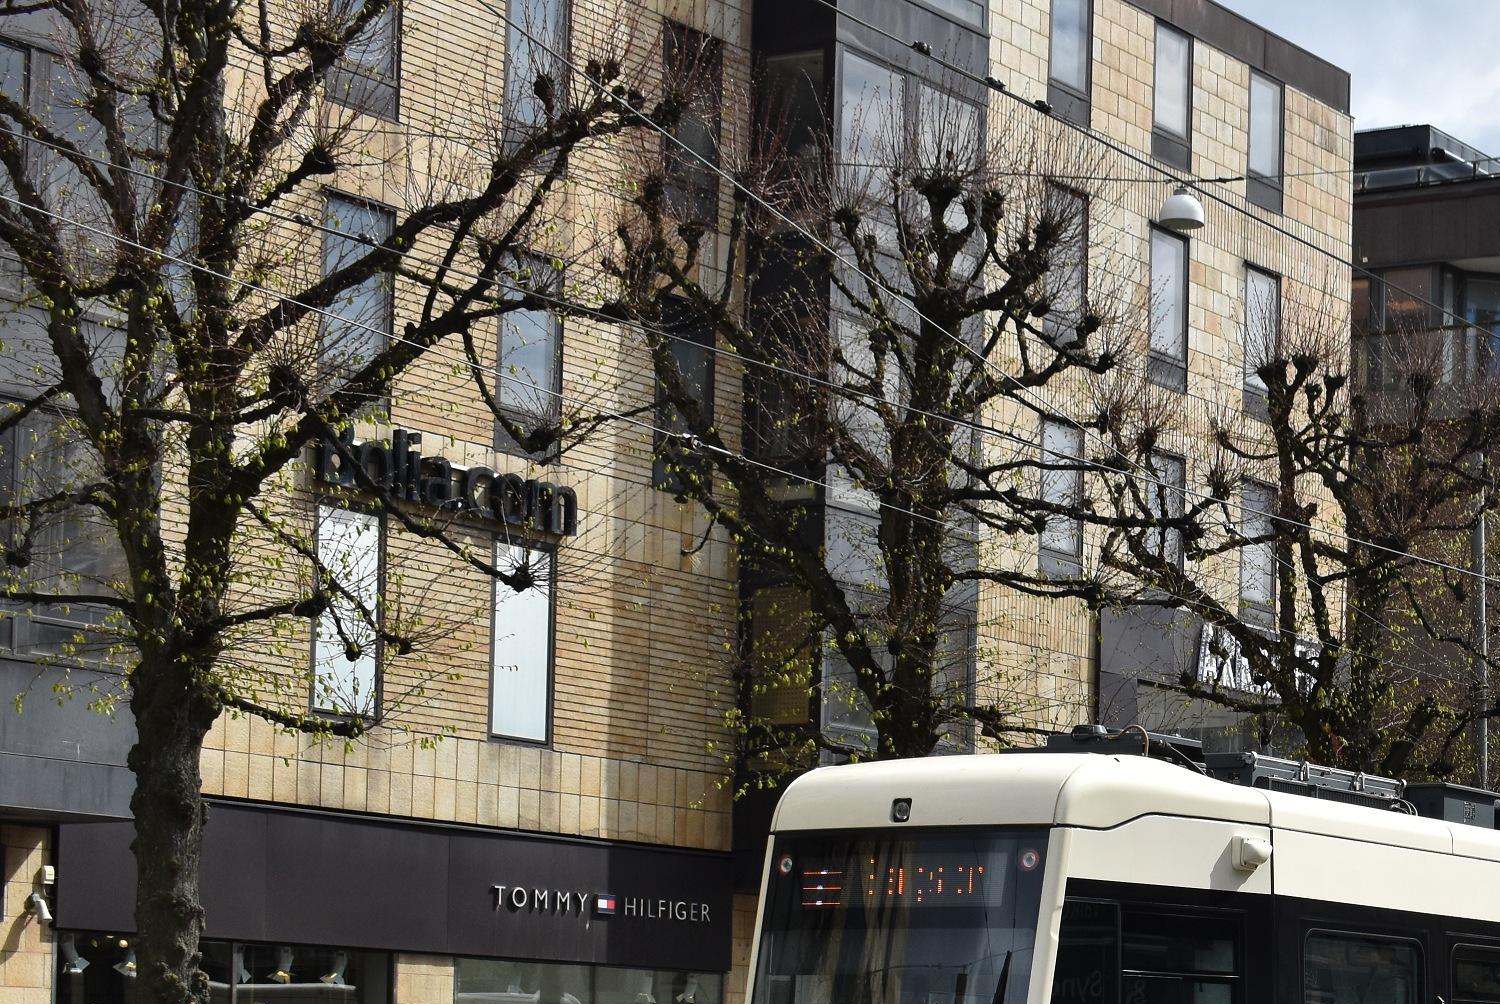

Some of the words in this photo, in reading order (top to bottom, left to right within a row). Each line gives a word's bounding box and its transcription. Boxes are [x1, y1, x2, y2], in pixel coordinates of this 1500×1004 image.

[320, 422, 578, 537] Bolia.com
[494, 885, 588, 912] TOMMY
[624, 897, 711, 922] HILFIGER
